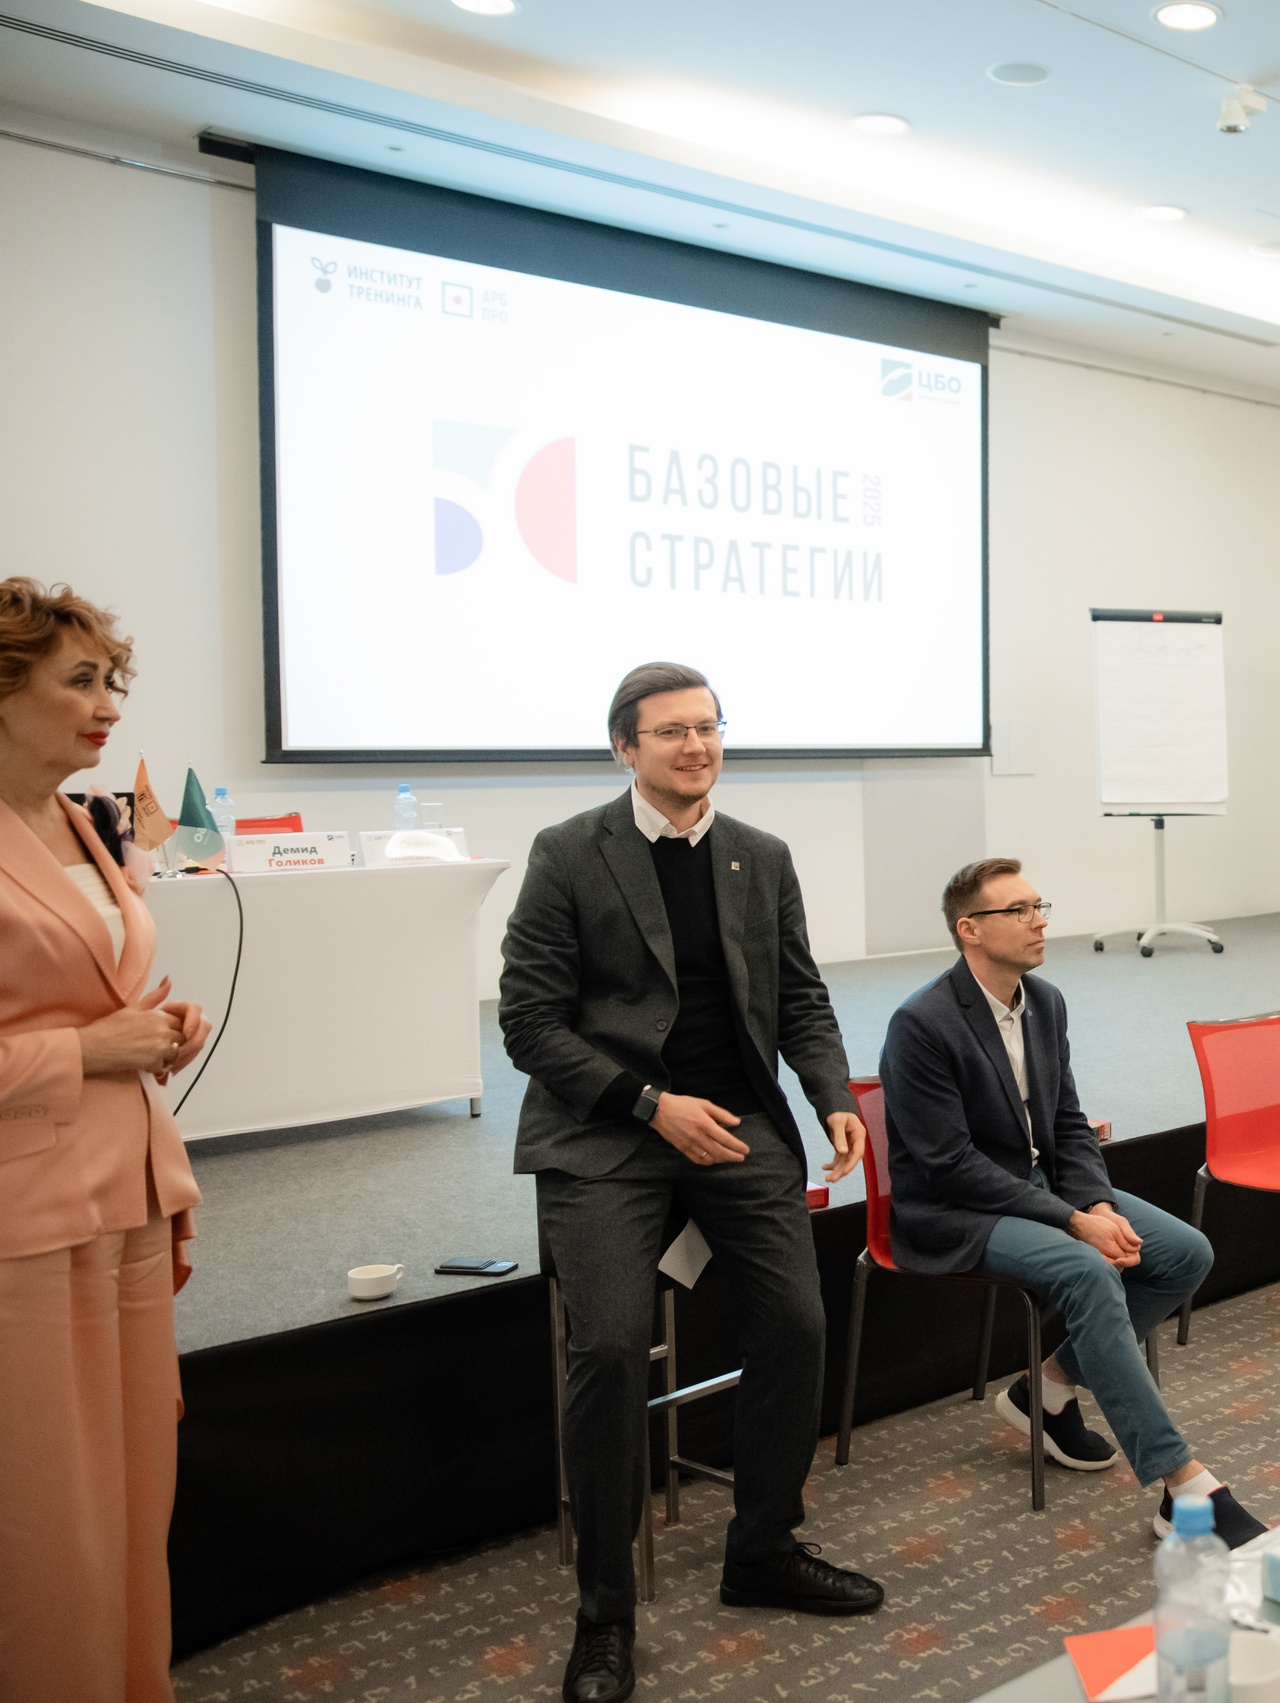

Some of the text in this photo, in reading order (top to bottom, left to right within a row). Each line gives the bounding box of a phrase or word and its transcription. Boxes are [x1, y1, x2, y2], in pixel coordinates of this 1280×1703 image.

[347, 264, 423, 290] ИНСТИТУТ
[347, 284, 423, 310] ТРЕНИНГА
[481, 289, 509, 307] АРБ
[481, 307, 509, 325] ПРО
[917, 369, 962, 394] ЦБО
[628, 443, 851, 525] БАЗОВЫЕ
[861, 473, 883, 527] 2025
[629, 530, 884, 604] СТРАТЕГИИ
[268, 858, 325, 868] Голиков
[272, 845, 318, 857] Демид
